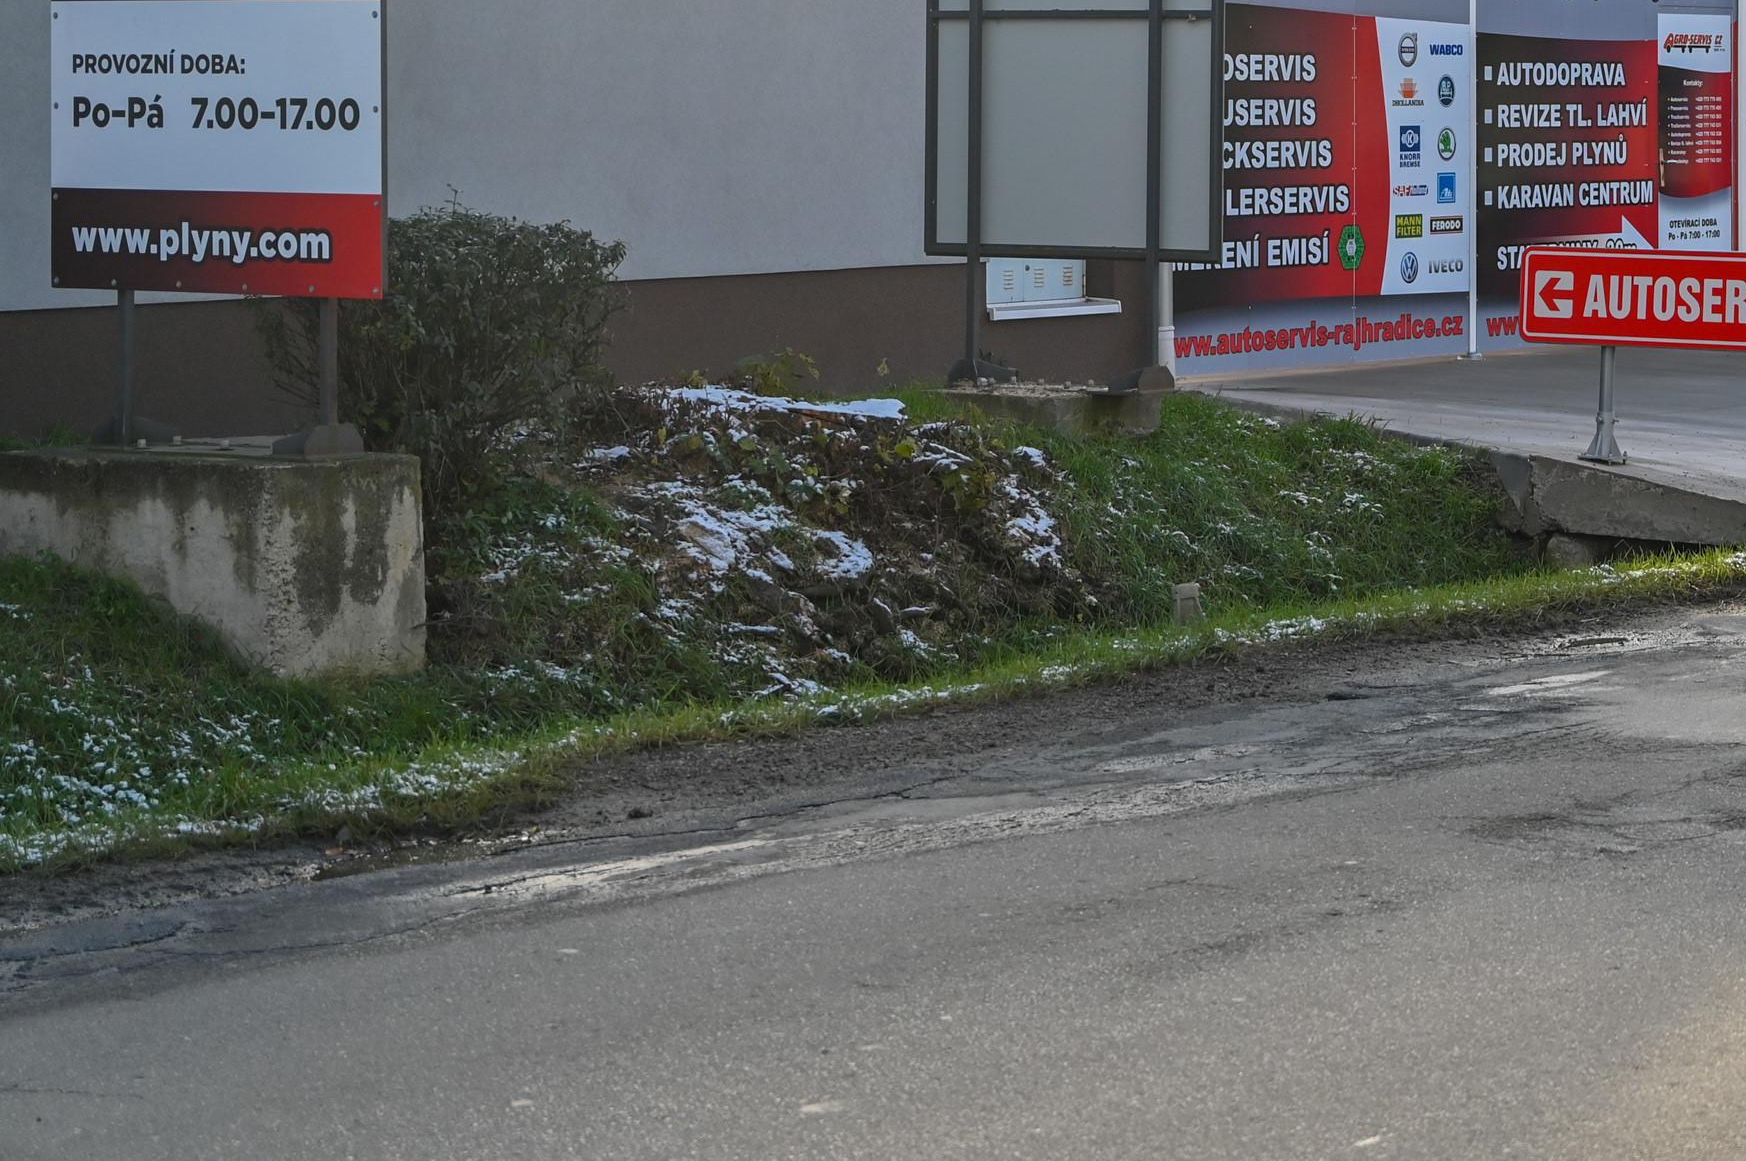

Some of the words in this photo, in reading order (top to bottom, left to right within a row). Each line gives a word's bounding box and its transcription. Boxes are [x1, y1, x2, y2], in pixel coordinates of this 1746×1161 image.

[1429, 44, 1463, 56] WABCO
[71, 49, 177, 75] PROVOZNÍ
[180, 53, 247, 75] DOBA:
[1497, 62, 1626, 86] AUTODOPRAVA
[1497, 103, 1562, 128] REVIZE
[1566, 103, 1592, 127] TL.
[1597, 97, 1648, 126] LAHVÍ
[1399, 153, 1421, 161] KNORR
[1497, 142, 1567, 167] PRODEJ
[1572, 133, 1627, 166] PLYNŮ
[1497, 184, 1574, 209] KARAVAN
[1578, 180, 1654, 207] CENTRUM
[1396, 216, 1422, 226] MANN
[1431, 220, 1461, 231] FERODO
[1701, 218, 1718, 227] DOBA
[1396, 226, 1422, 236] FILTER
[1668, 232, 1676, 240] Po
[71, 221, 331, 263] www.plyny.com
[1267, 230, 1330, 267] EMISÍ
[1428, 259, 1464, 274] IVECO
